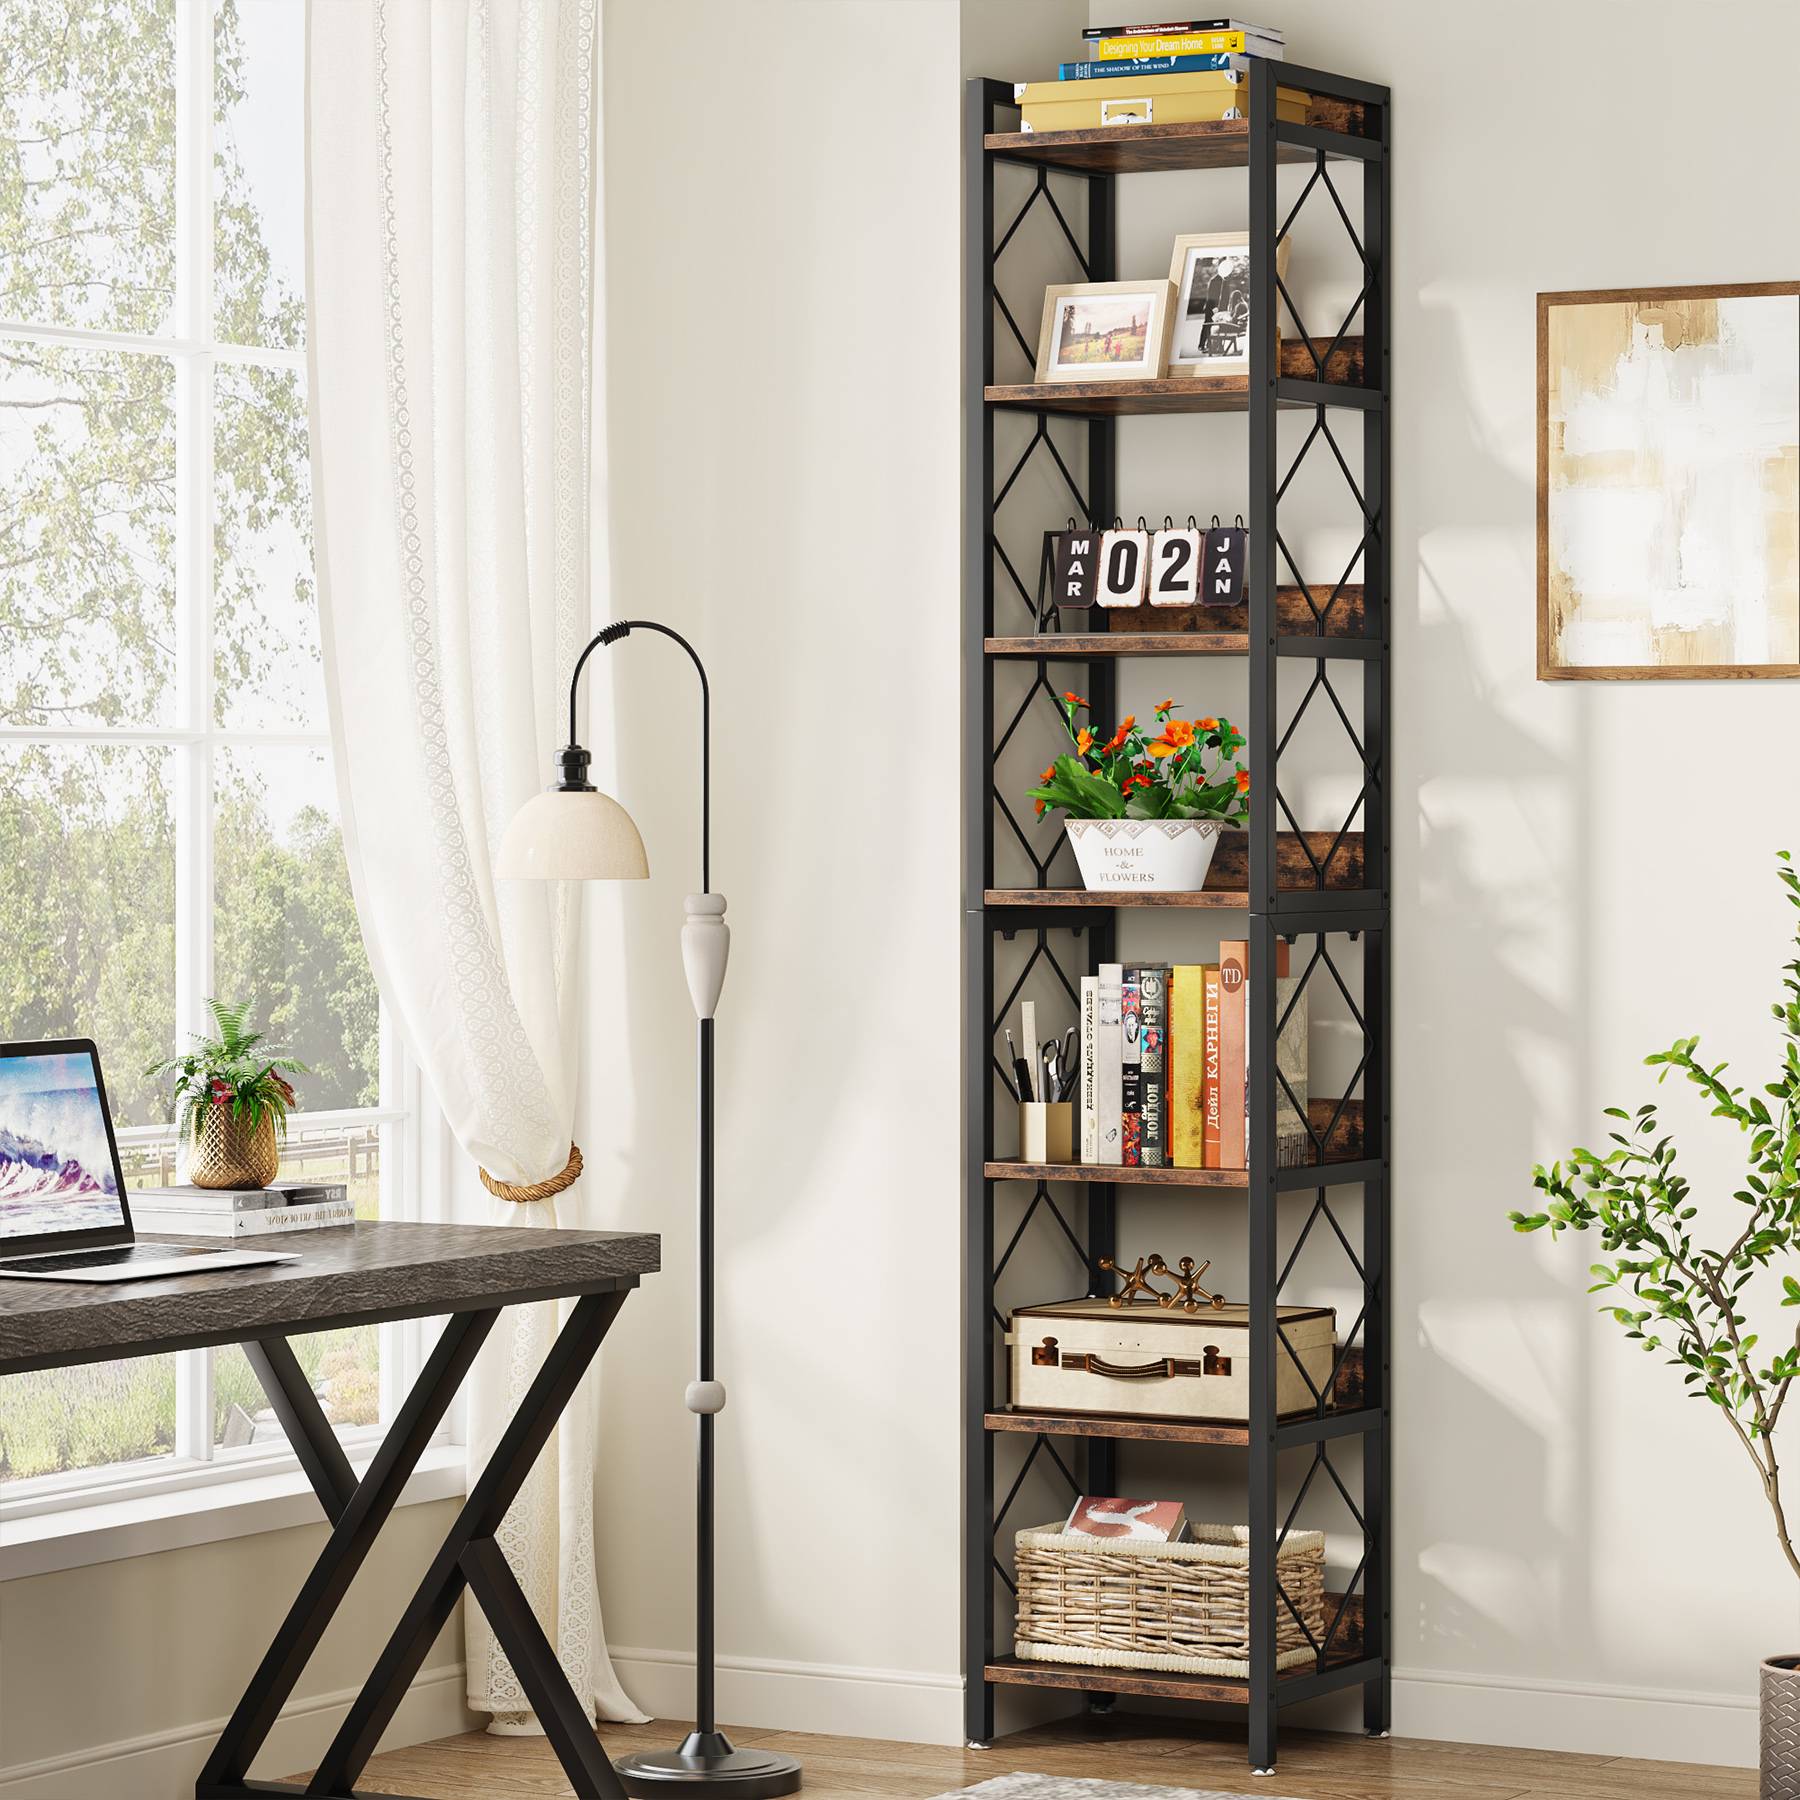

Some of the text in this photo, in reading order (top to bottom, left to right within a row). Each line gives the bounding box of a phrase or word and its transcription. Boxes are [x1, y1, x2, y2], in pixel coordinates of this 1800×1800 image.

[1103, 38, 1203, 57] Designing Your Dream Home
[1152, 62, 1170, 70] WIND
[1066, 540, 1089, 596] MAR
[1214, 537, 1232, 594] JAN
[1104, 847, 1144, 857] HOME
[1099, 873, 1155, 882] FLOWERS
[1222, 968, 1241, 984] TD
[1206, 982, 1220, 1129] Дейл КАРНЕГИ
